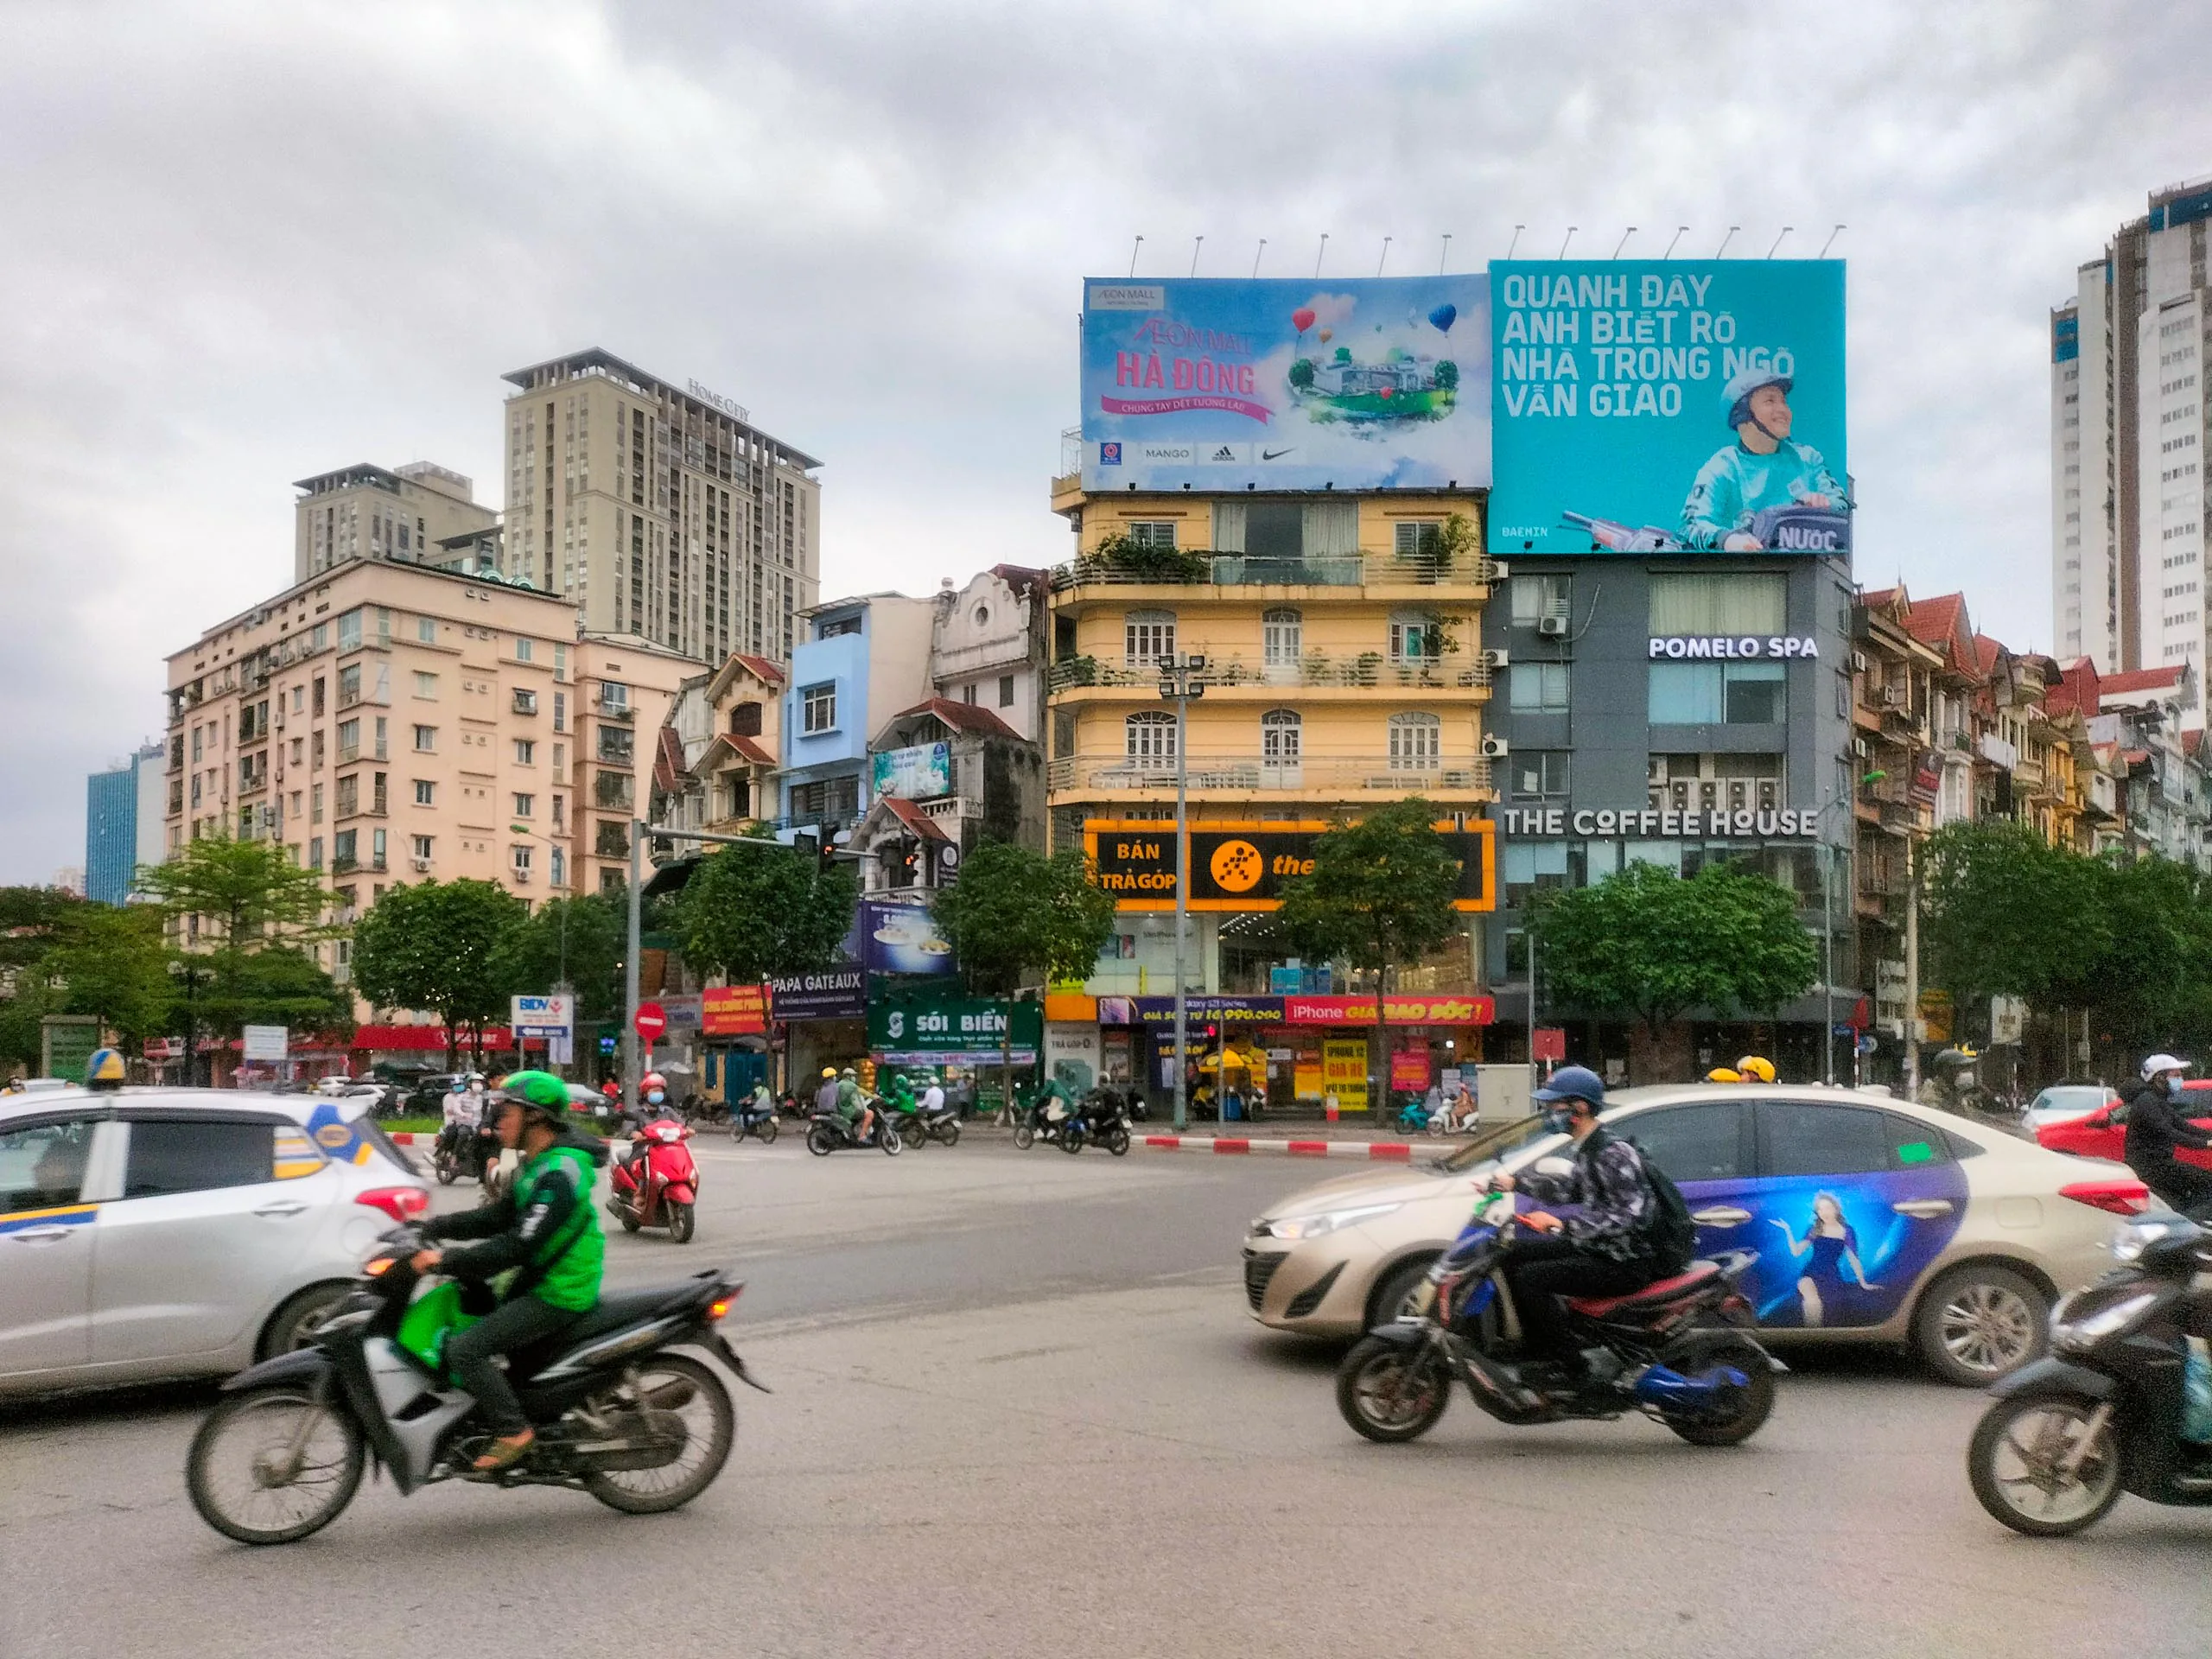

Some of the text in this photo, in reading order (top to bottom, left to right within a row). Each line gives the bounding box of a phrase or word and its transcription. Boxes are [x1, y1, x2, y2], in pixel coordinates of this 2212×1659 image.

[1128, 289, 1155, 299] MALL
[1503, 274, 1713, 308] QUANH ĐÂY
[1502, 310, 1736, 344] ANH BIẾT RÕ
[1209, 328, 1252, 355] MALL
[1116, 348, 1255, 395] HÀ ĐÔNG
[1503, 347, 1580, 380] NHÀ
[1591, 346, 1710, 380] TRONG
[688, 377, 751, 423] HOME CITY
[1122, 404, 1154, 414] CHUNG
[1156, 402, 1172, 412] TAY
[1590, 384, 1681, 416] GIAO
[1146, 449, 1190, 458] MANGO
[1502, 527, 1548, 537] BAEMIN
[1649, 638, 1819, 658] POMELO SPA
[1504, 810, 1819, 836] THE COFFEE HOUSE
[1117, 839, 1160, 860] BÁN
[1100, 868, 1177, 889] TRẢ GÓP
[772, 977, 802, 993] PAPA
[520, 998, 550, 1010] BIDV
[1294, 1006, 1343, 1019] iPhone
[917, 1008, 1008, 1032] SÓI BIỂN
